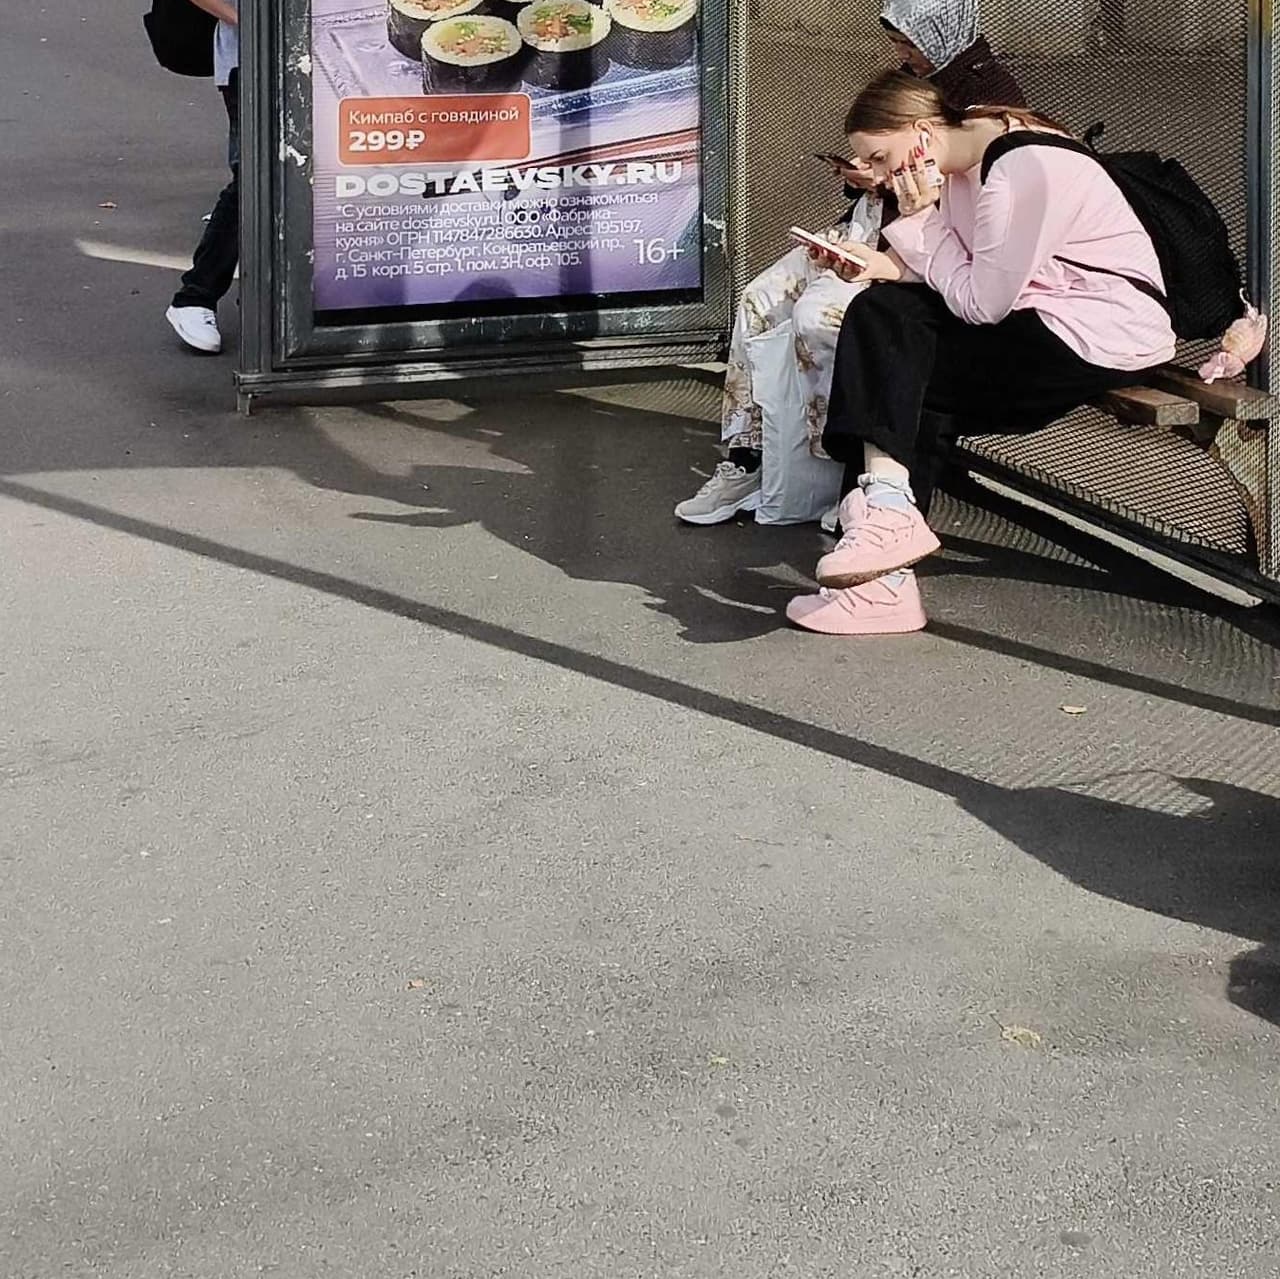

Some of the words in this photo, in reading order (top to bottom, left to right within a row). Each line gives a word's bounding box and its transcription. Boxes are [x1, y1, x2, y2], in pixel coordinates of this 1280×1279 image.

[349, 109, 415, 125] Кимпаб
[418, 113, 429, 124] с
[430, 106, 520, 124] говядиной
[348, 128, 426, 152] 299₽
[335, 160, 683, 198] DOSTAEVSKY.RU
[356, 202, 438, 220] условиями
[439, 199, 506, 216] доставки
[508, 196, 557, 210] можно
[559, 191, 659, 208] ознакомиться
[335, 221, 354, 233] на
[356, 217, 400, 231] сайте
[504, 210, 541, 225] ООО
[335, 236, 385, 252] кухня»
[386, 232, 430, 246] ОГРН
[482, 239, 600, 257] Кондратьевский
[632, 237, 686, 266] 16+
[350, 264, 367, 277] 15
[371, 265, 411, 281] корп.
[413, 261, 424, 274] 5
[555, 252, 583, 266] 105.
